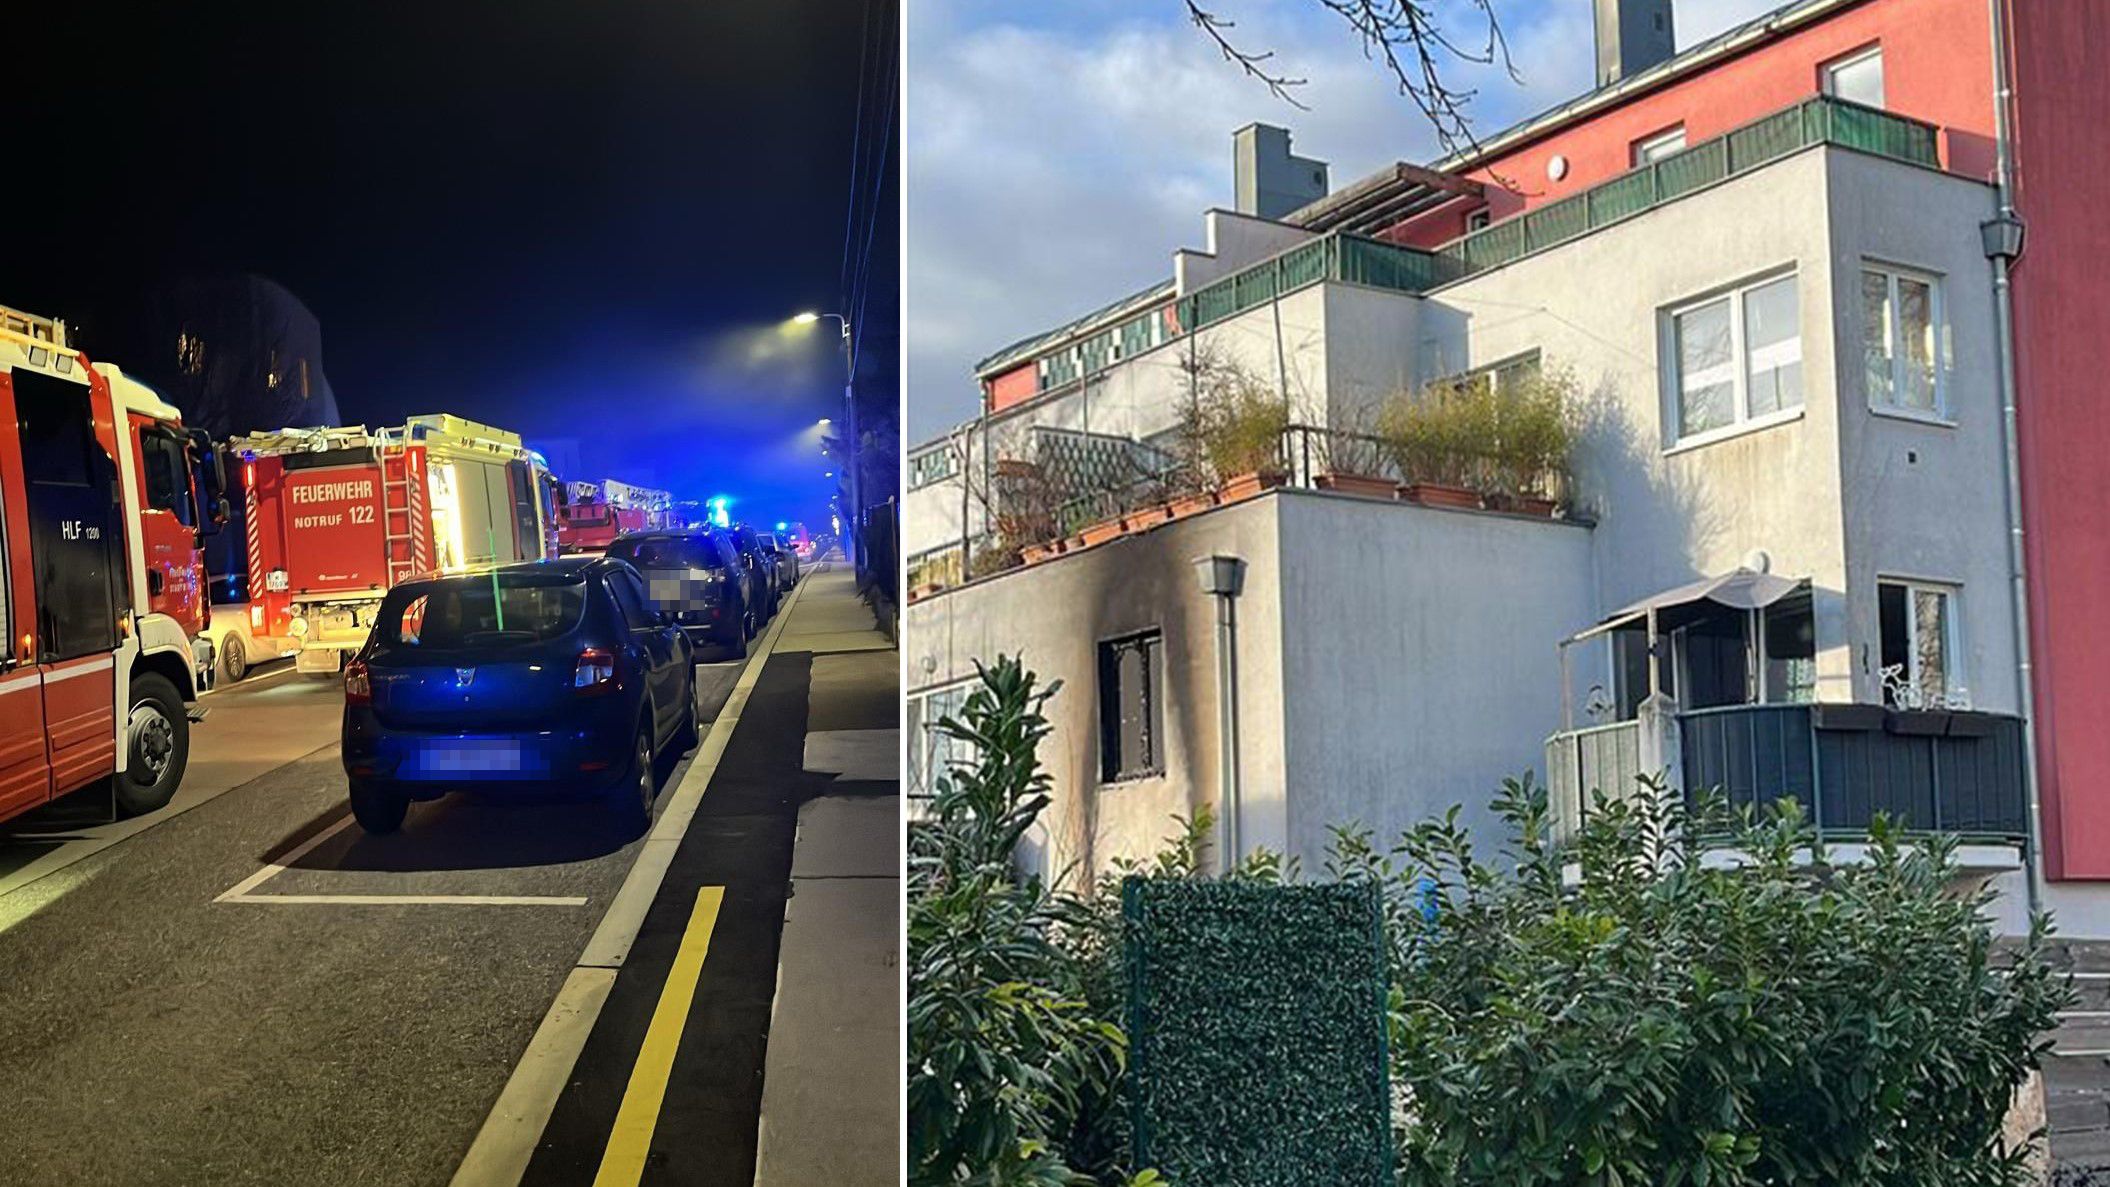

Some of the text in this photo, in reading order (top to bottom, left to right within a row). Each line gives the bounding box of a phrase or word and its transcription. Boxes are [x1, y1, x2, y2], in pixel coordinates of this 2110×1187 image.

[292, 480, 373, 504] FEUERWEHR
[294, 505, 375, 529] NOTRUF 122
[62, 520, 82, 540] HLF
